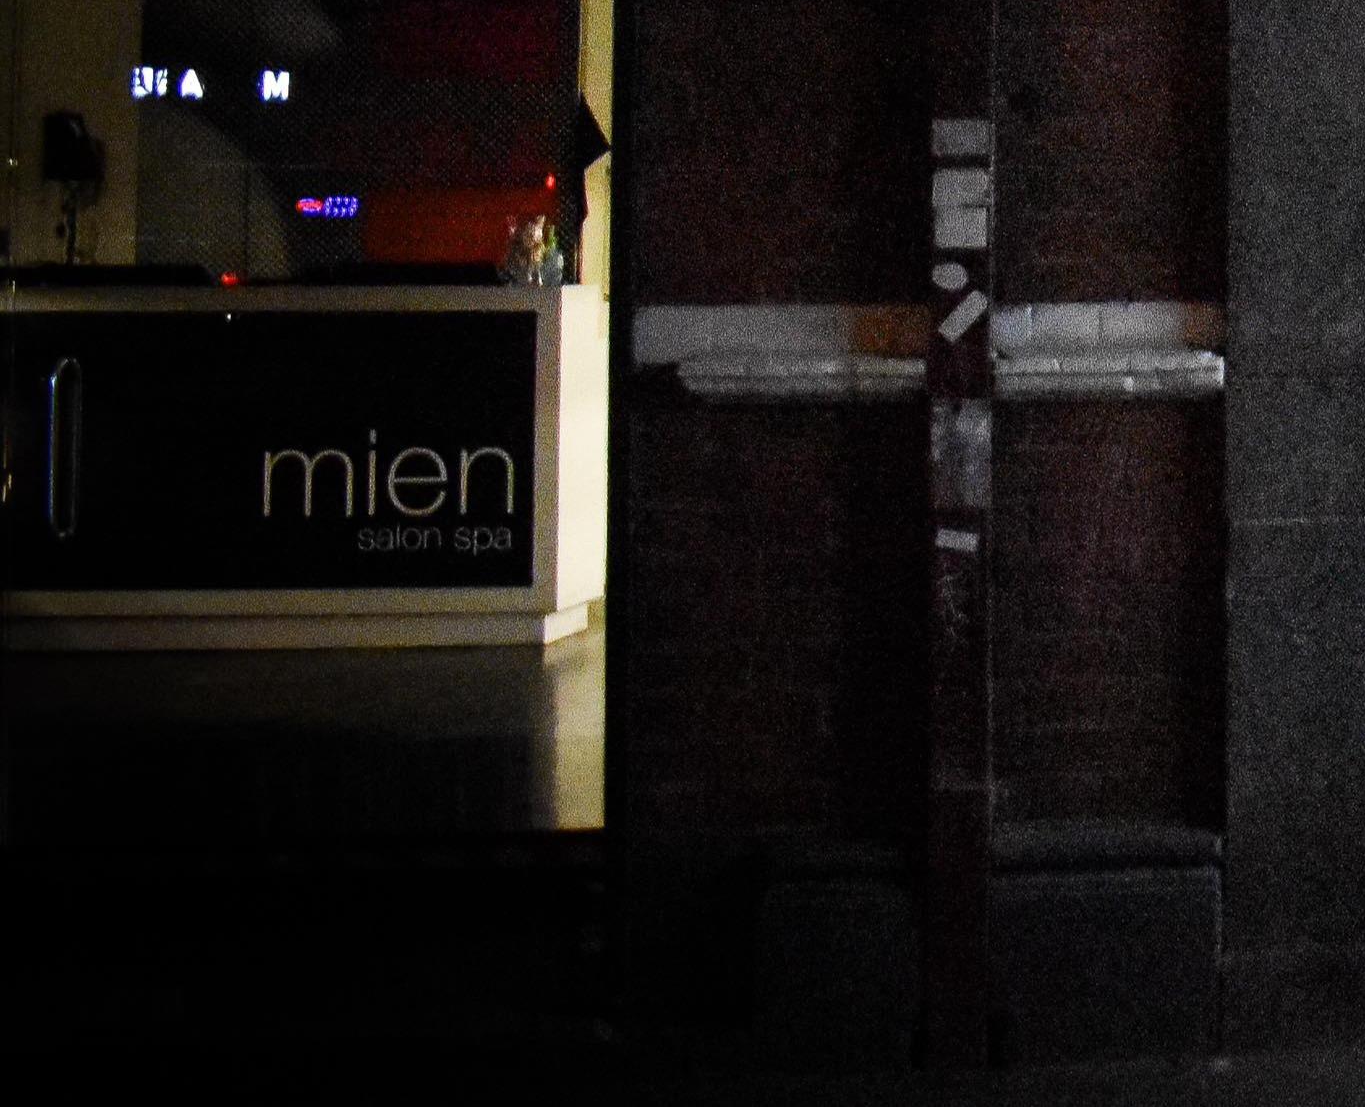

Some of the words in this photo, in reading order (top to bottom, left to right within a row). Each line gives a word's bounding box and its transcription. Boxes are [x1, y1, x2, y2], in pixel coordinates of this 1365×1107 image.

[262, 428, 515, 518] mien
[357, 525, 443, 552] salon
[453, 526, 513, 557] spa
